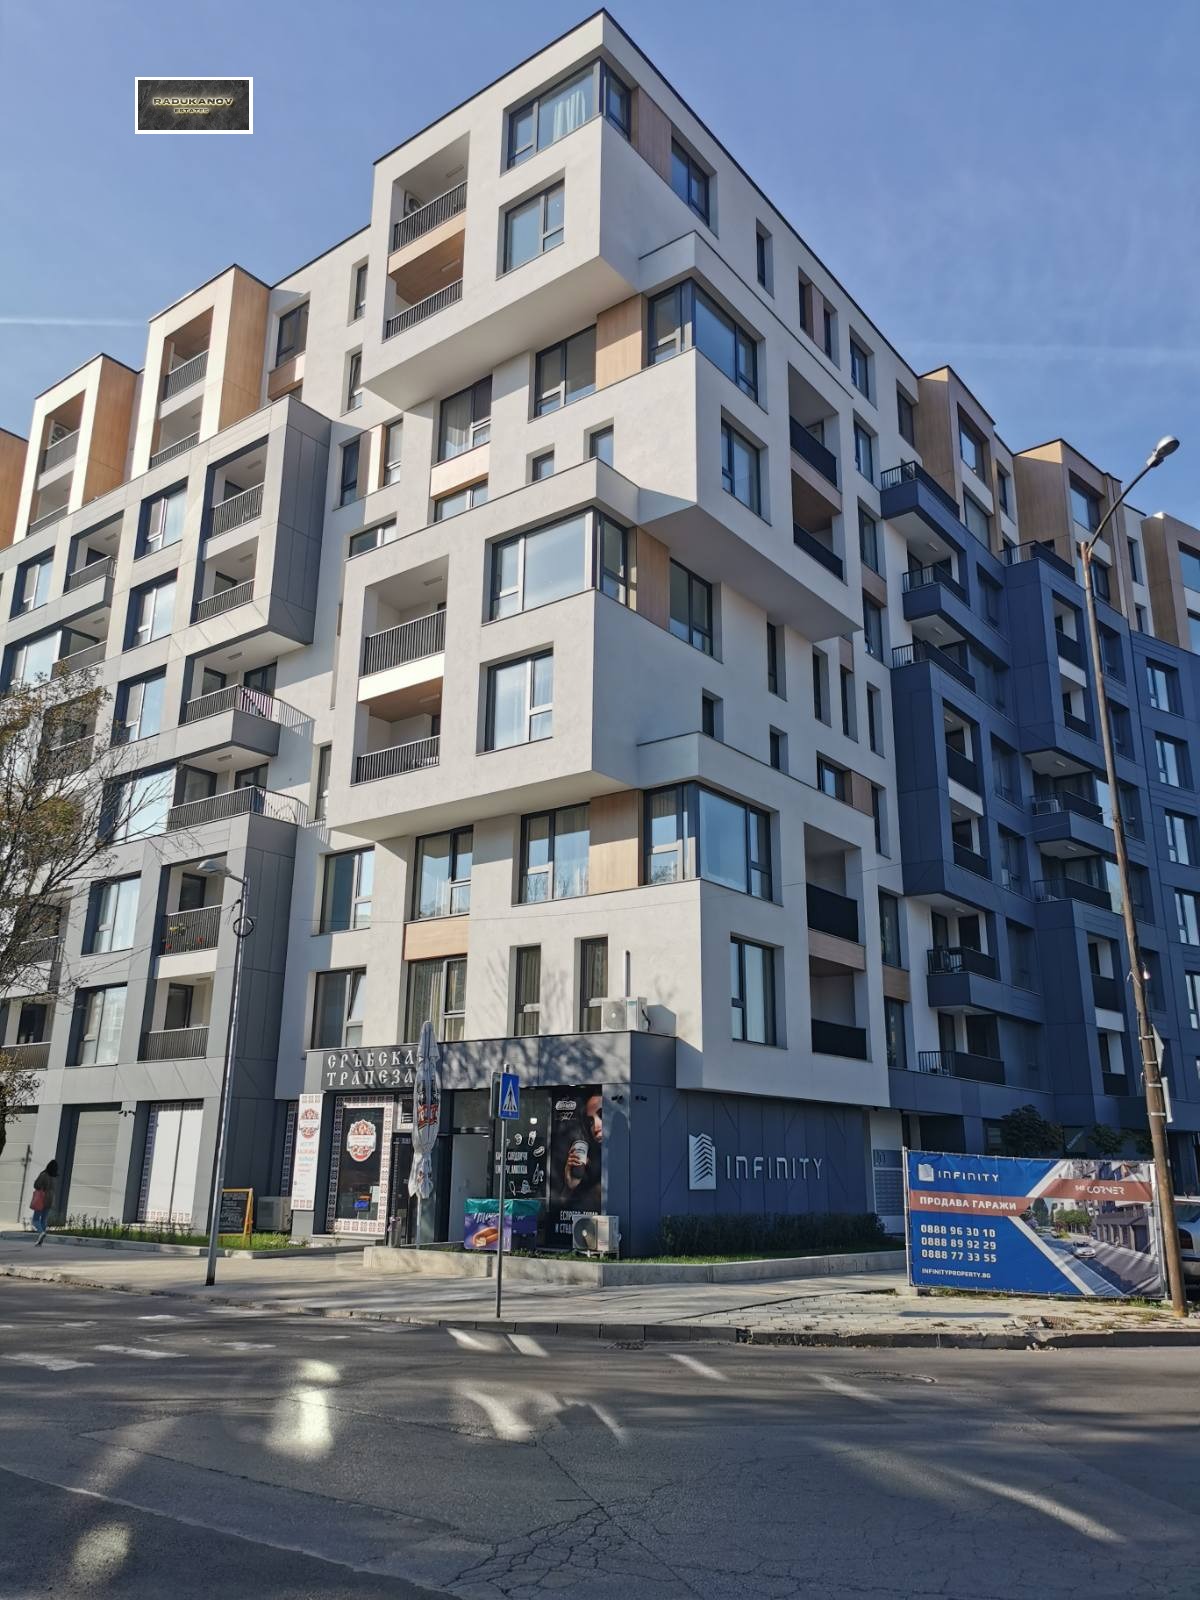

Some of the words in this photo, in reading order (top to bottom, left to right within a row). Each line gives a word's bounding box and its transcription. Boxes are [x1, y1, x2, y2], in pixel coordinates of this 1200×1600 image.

[327, 1068, 414, 1086] ТРАПЕЗА
[726, 1155, 823, 1179] INFINITY
[938, 1170, 999, 1182] INFINITY
[1086, 1185, 1126, 1195] CORNER
[920, 1196, 969, 1208] ПРОДАВА
[972, 1199, 1017, 1211] ГАРАЖИ
[921, 1224, 947, 1234] 0888
[950, 1226, 963, 1235] 96
[966, 1227, 979, 1237] 30
[983, 1229, 996, 1238] 10
[921, 1237, 947, 1247] 0888
[950, 1239, 963, 1248] 89
[967, 1240, 980, 1249] 92
[983, 1241, 997, 1250] 29
[921, 1249, 948, 1259] 0888
[951, 1251, 964, 1260] 77
[967, 1252, 980, 1262] 33
[983, 1253, 997, 1263] 55
[922, 1268, 992, 1279] INFINITYPROPERTY.BG
